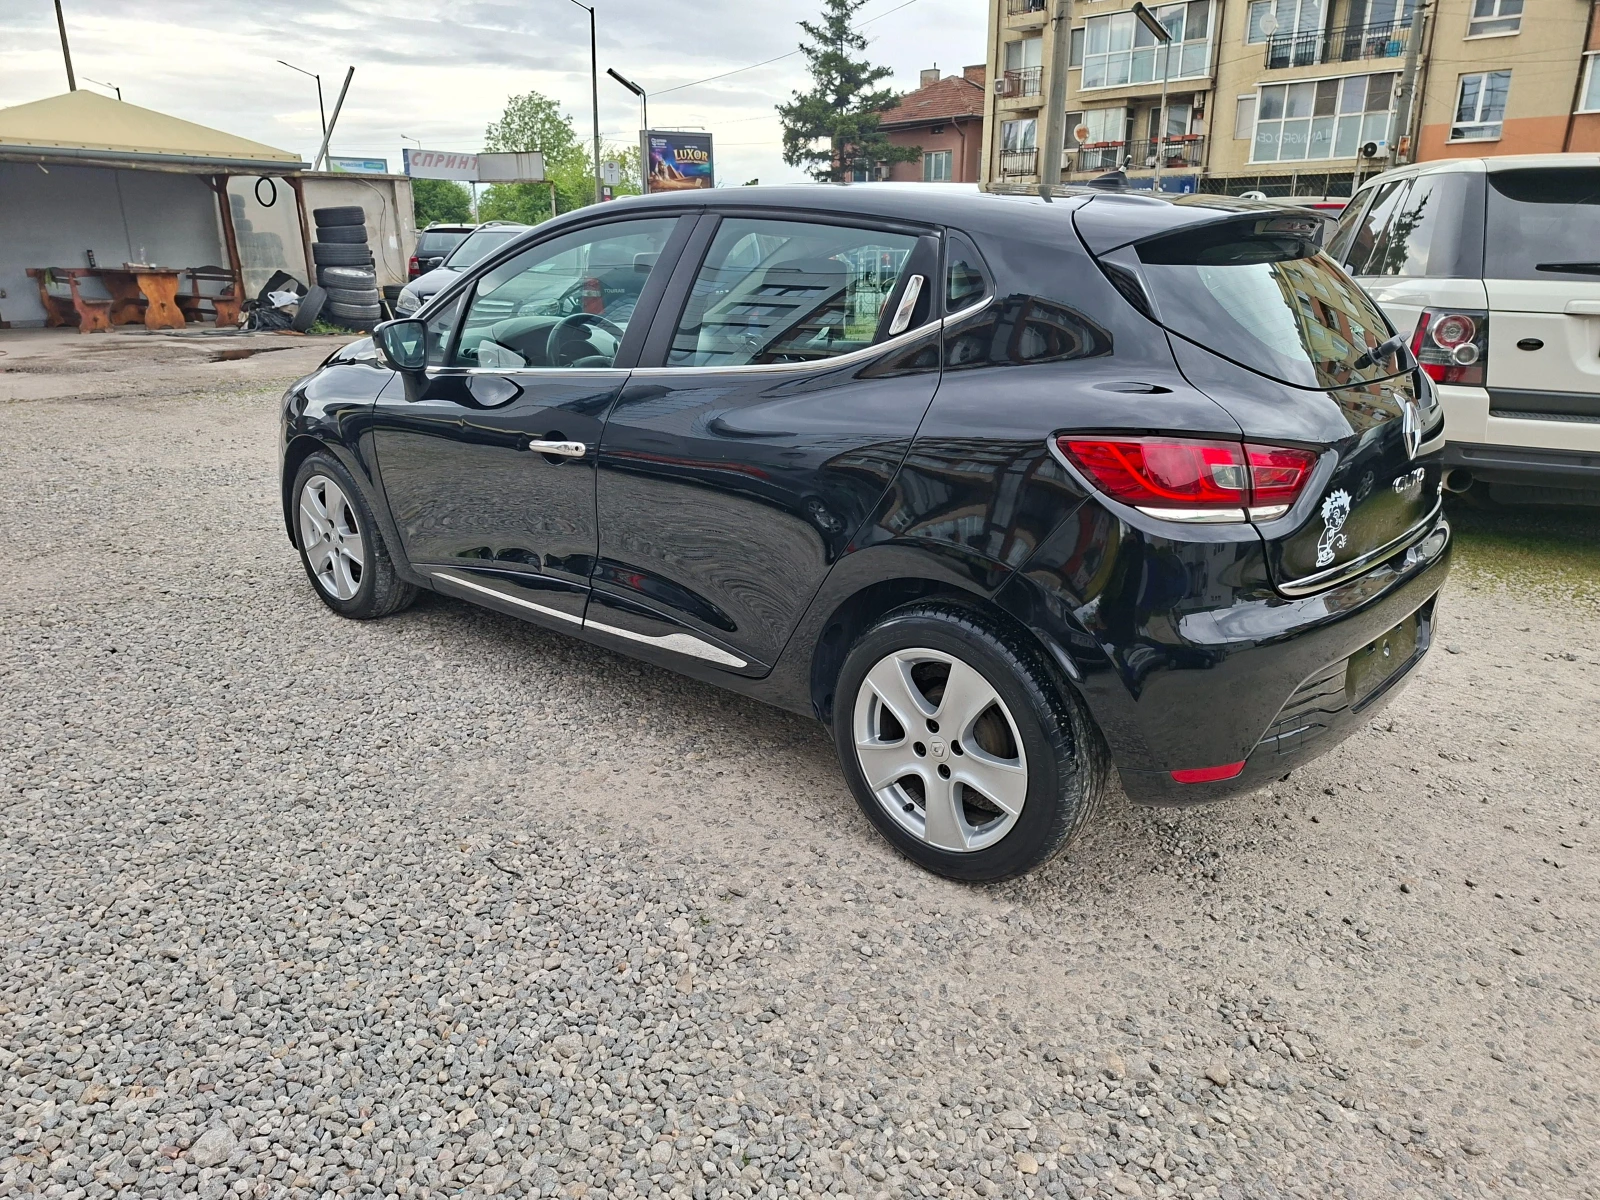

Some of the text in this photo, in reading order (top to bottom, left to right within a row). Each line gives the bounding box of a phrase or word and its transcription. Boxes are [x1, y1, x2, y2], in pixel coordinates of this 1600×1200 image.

[411, 152, 478, 170] СПРИНТ
[673, 148, 709, 162] LUXOR
[1392, 467, 1425, 494] CLIO
